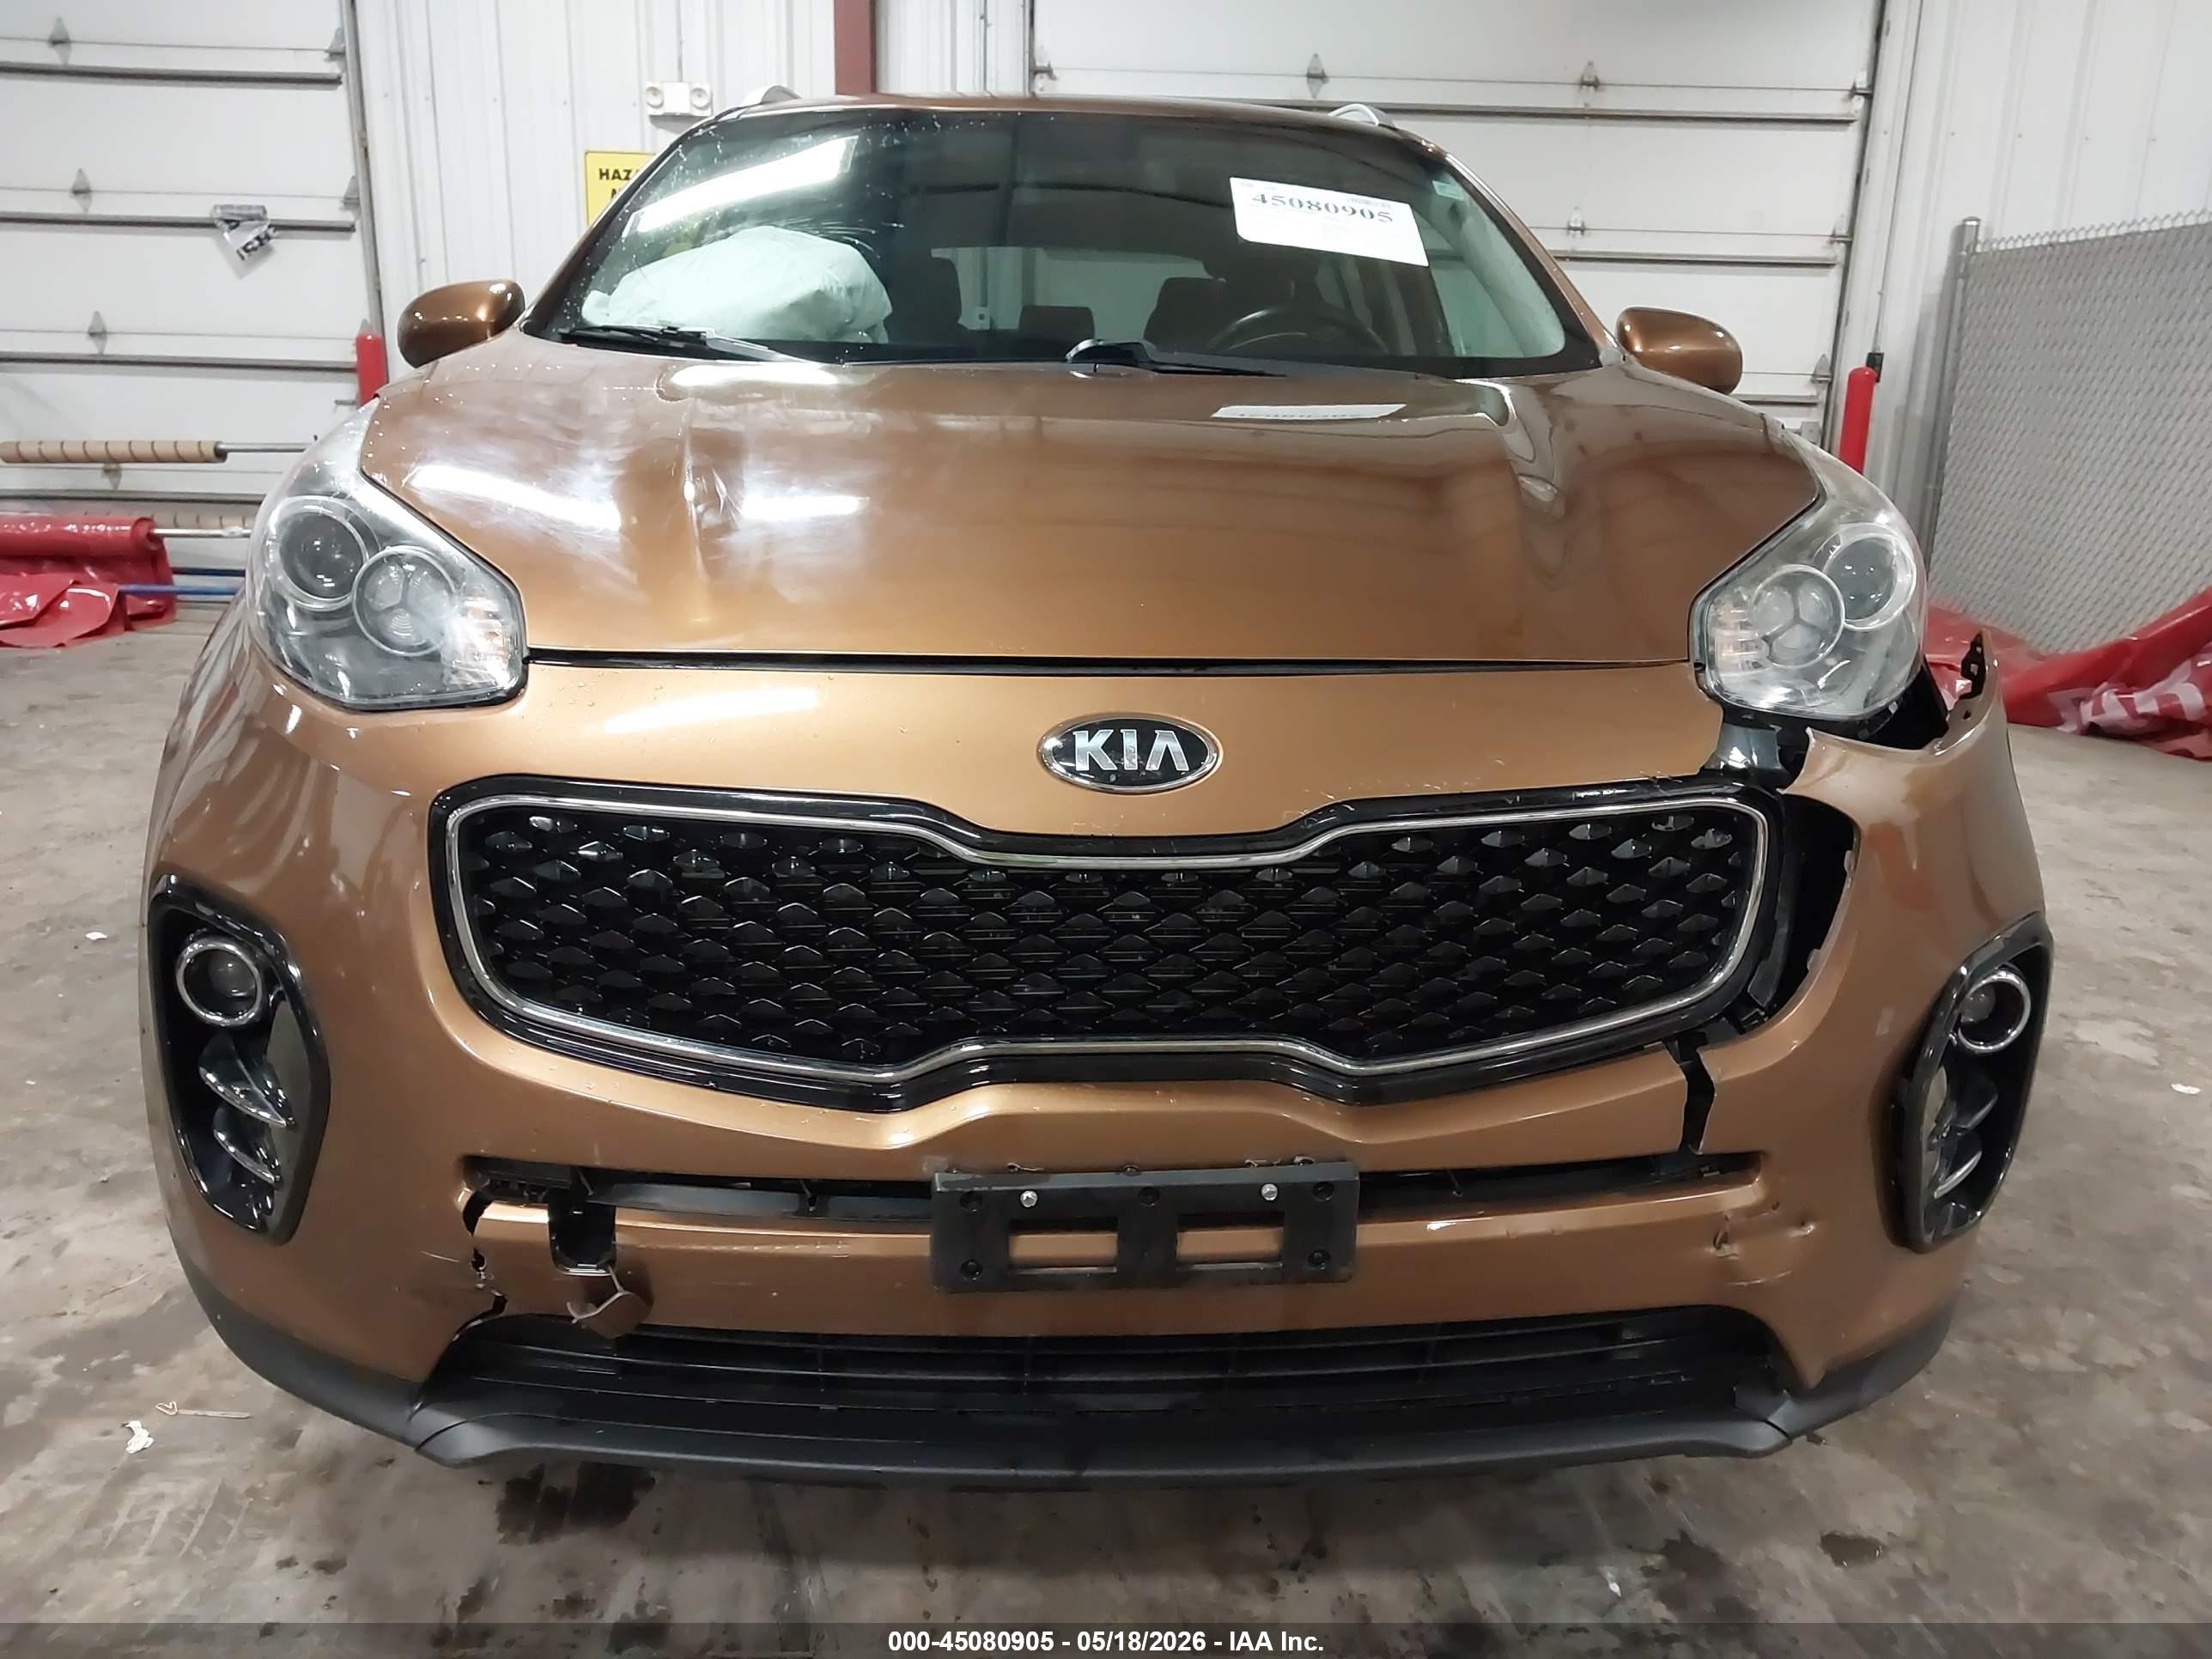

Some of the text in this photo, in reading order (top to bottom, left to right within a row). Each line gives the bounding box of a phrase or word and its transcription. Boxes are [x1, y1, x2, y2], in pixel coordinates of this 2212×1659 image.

[599, 168, 640, 181] HAZ
[1252, 193, 1394, 222] 45080905
[1073, 729, 1189, 771] KIA
